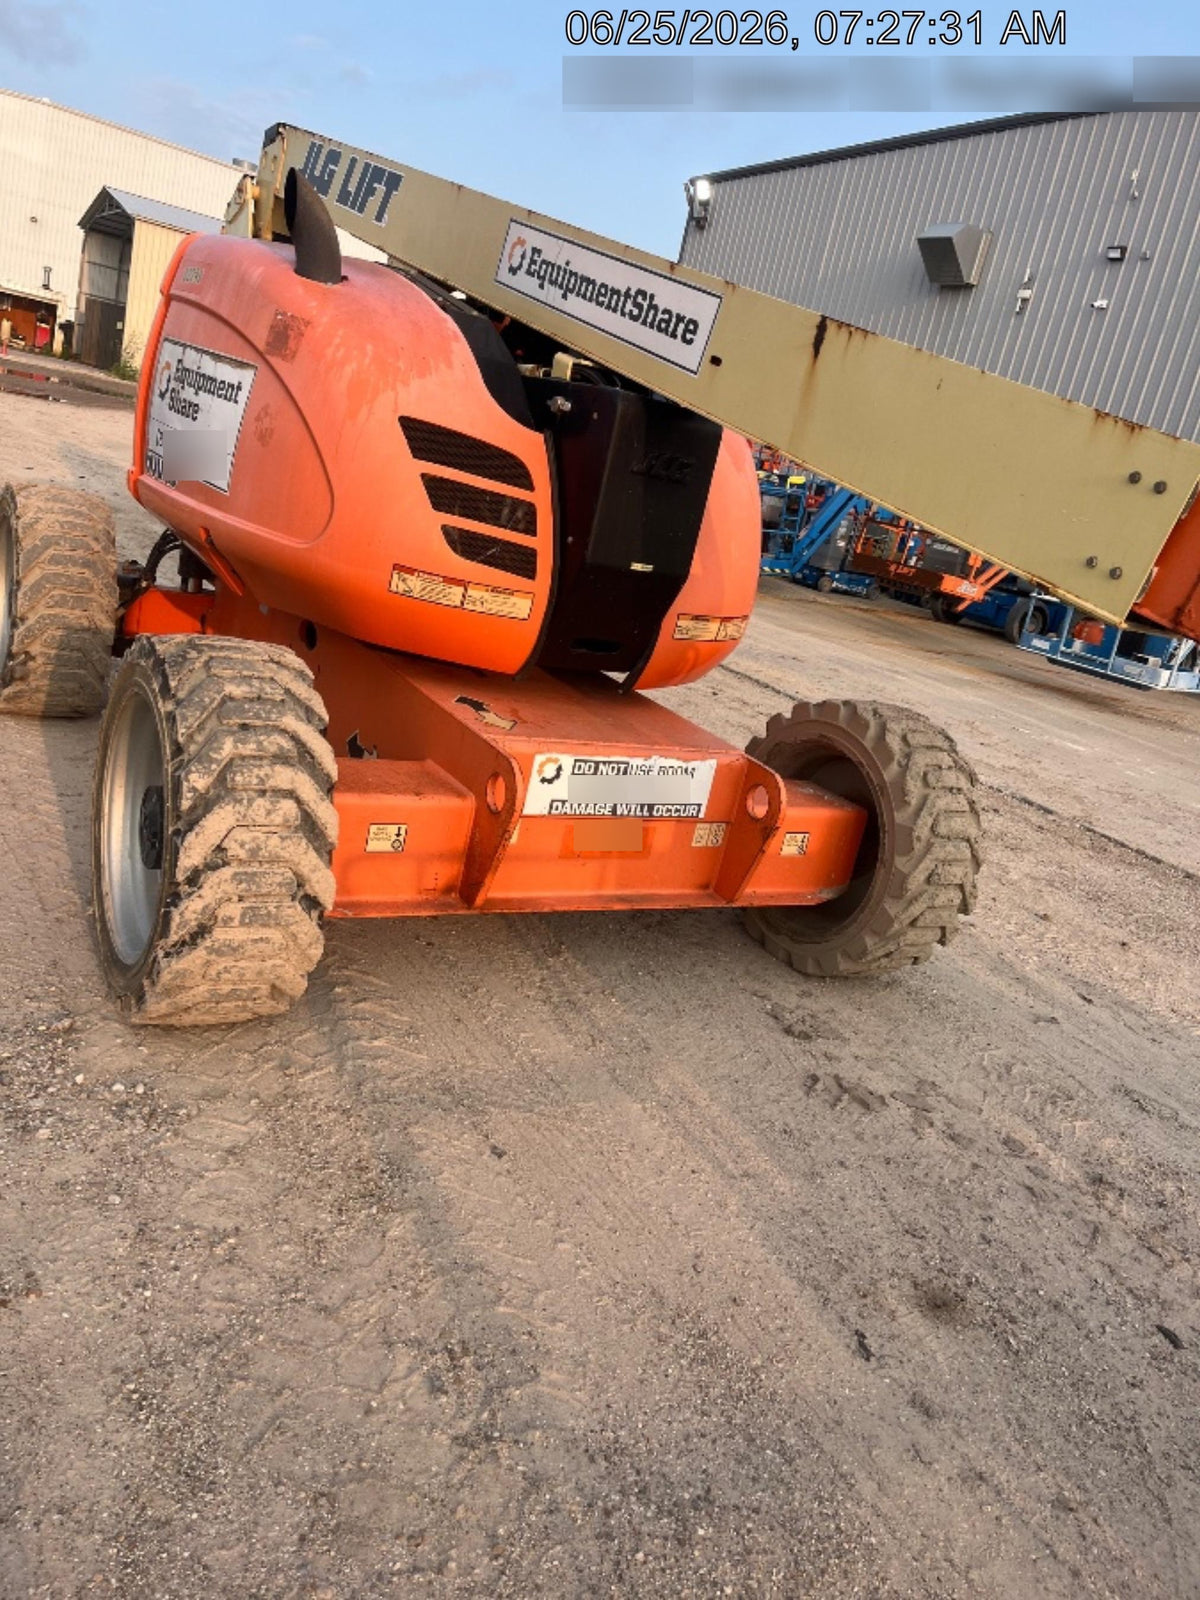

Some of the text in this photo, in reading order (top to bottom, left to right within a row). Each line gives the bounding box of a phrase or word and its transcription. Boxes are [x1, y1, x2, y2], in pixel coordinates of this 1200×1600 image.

[300, 140, 405, 228] JLG LIFT
[525, 246, 699, 346] EquipmentShare
[173, 358, 242, 404] Equipment
[168, 386, 200, 422] Share
[573, 761, 595, 775] DO
[599, 762, 628, 776] NOT
[550, 802, 699, 818] DAMAGE WILL OCCUR
